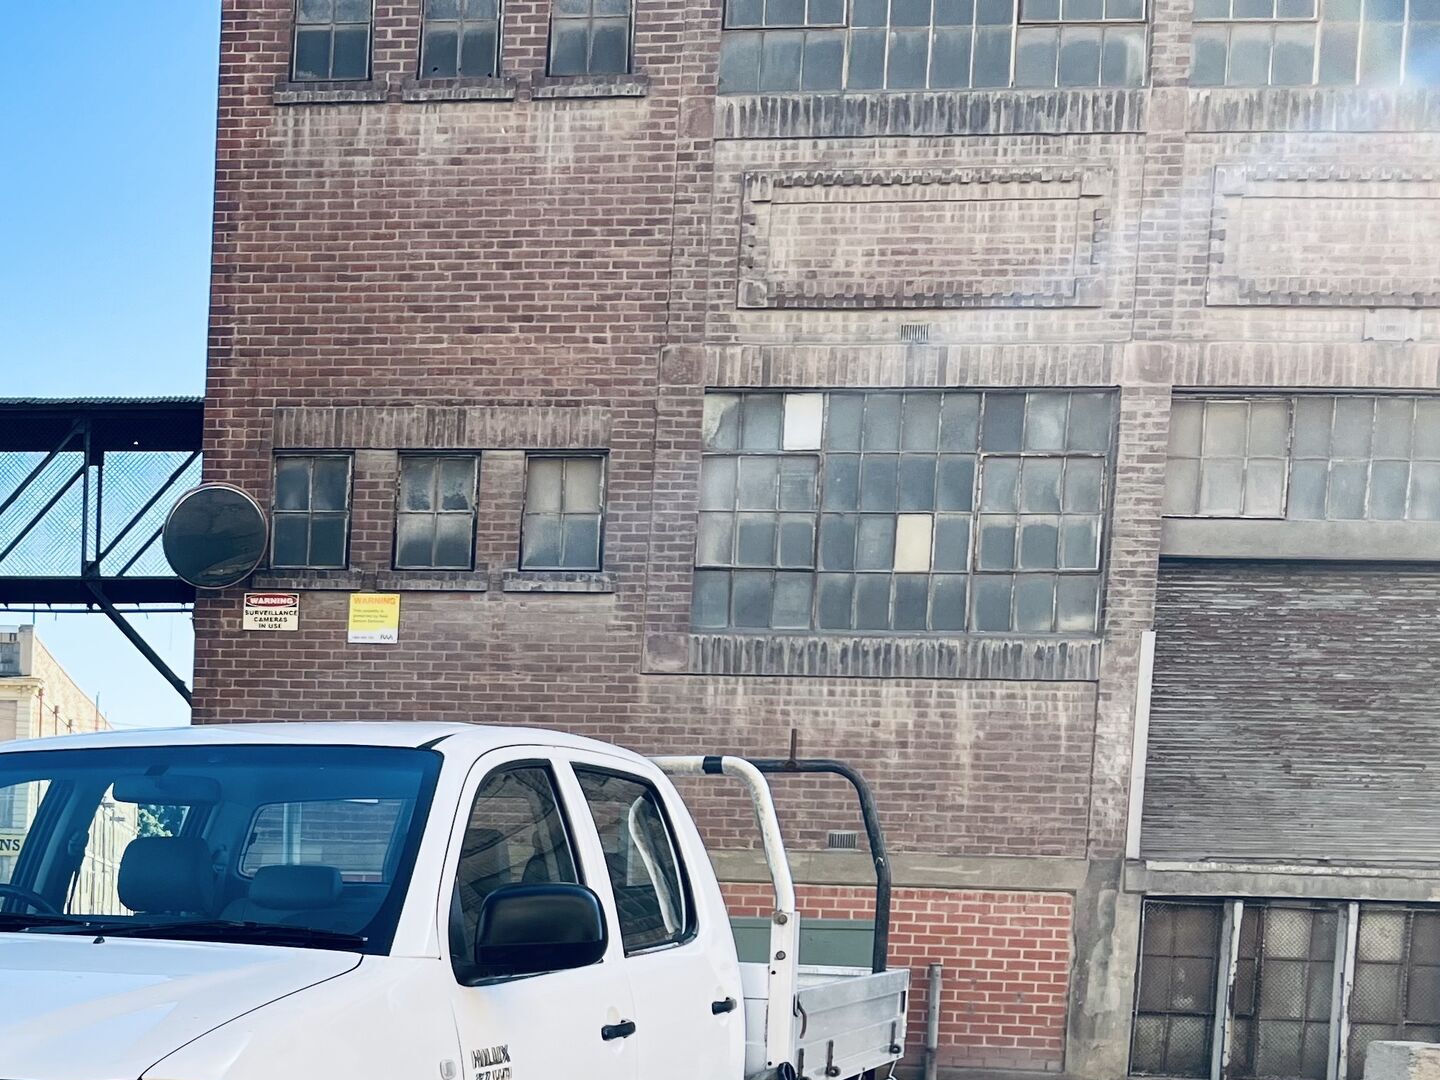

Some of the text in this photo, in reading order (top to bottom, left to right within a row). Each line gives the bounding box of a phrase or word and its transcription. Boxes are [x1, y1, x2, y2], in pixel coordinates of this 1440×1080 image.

[250, 597, 294, 605] WARNING
[353, 597, 396, 605] WARNING
[471, 1044, 511, 1069] HILUX
